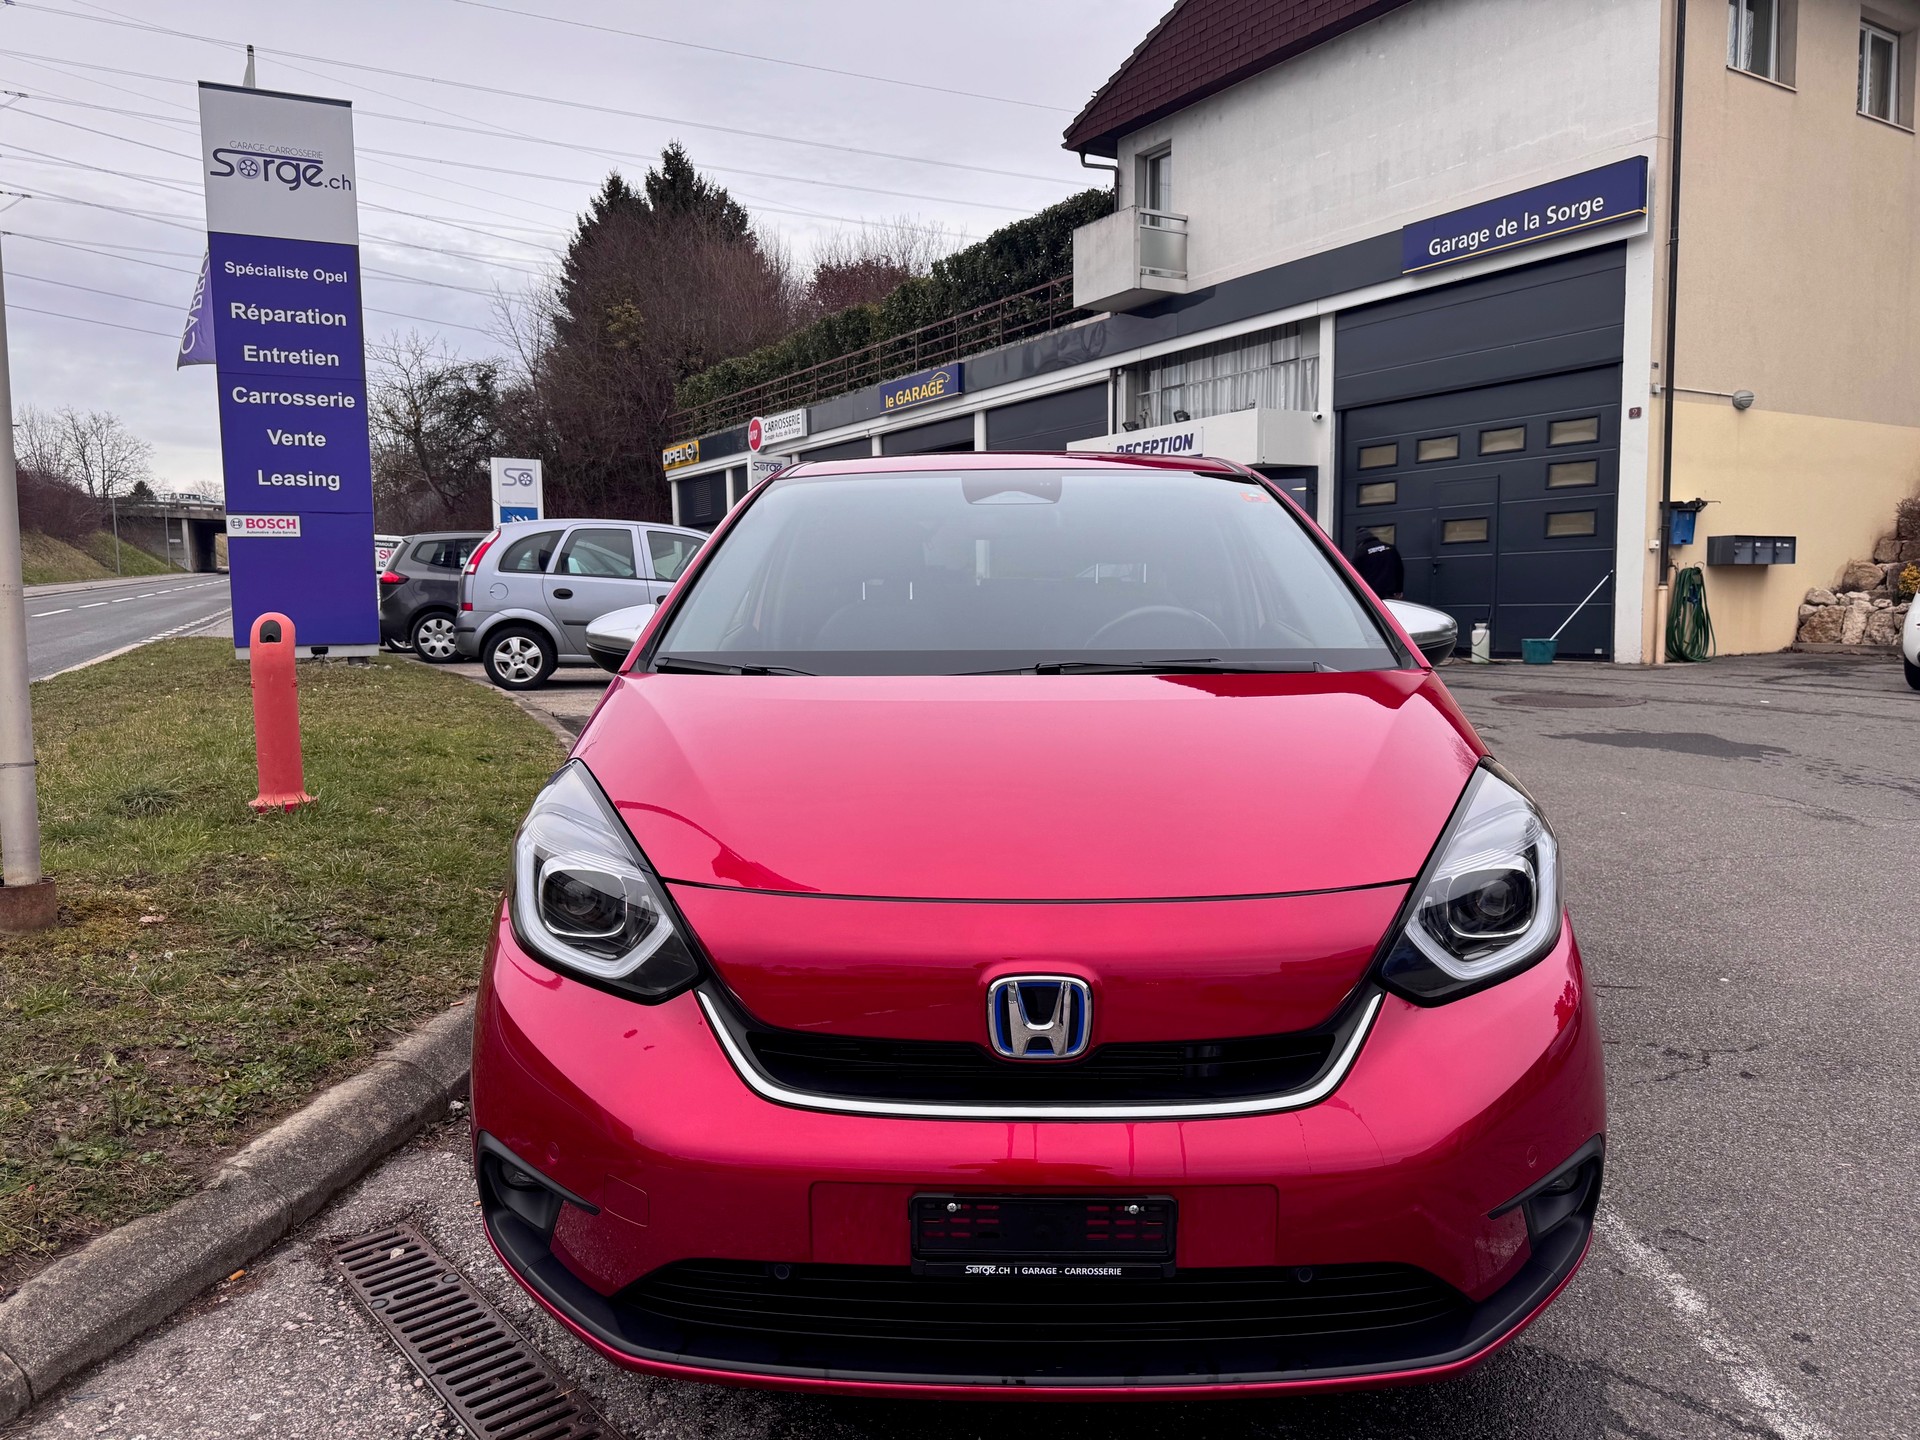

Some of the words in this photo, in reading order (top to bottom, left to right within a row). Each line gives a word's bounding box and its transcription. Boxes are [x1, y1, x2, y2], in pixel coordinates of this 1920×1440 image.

[1428, 228, 1490, 256] Garage
[1495, 219, 1518, 239] de
[1524, 212, 1540, 231] la
[1546, 197, 1604, 224] Sorge
[224, 261, 309, 280] Spécialiste
[313, 268, 348, 285] Opel
[230, 302, 347, 326] Réparation
[243, 345, 340, 367] Entretien
[232, 386, 356, 408] Carrosserie
[885, 394, 894, 408] le
[895, 379, 945, 406] GARAGE
[764, 413, 800, 434] CARROSSERIE
[267, 429, 327, 447] Vente
[663, 448, 686, 465] OPEL
[258, 470, 341, 491] Leasing
[246, 518, 297, 529] BOSCH
[1022, 1267, 1057, 1275] GARAGE
[1064, 1267, 1122, 1276] CARROSSERIE
